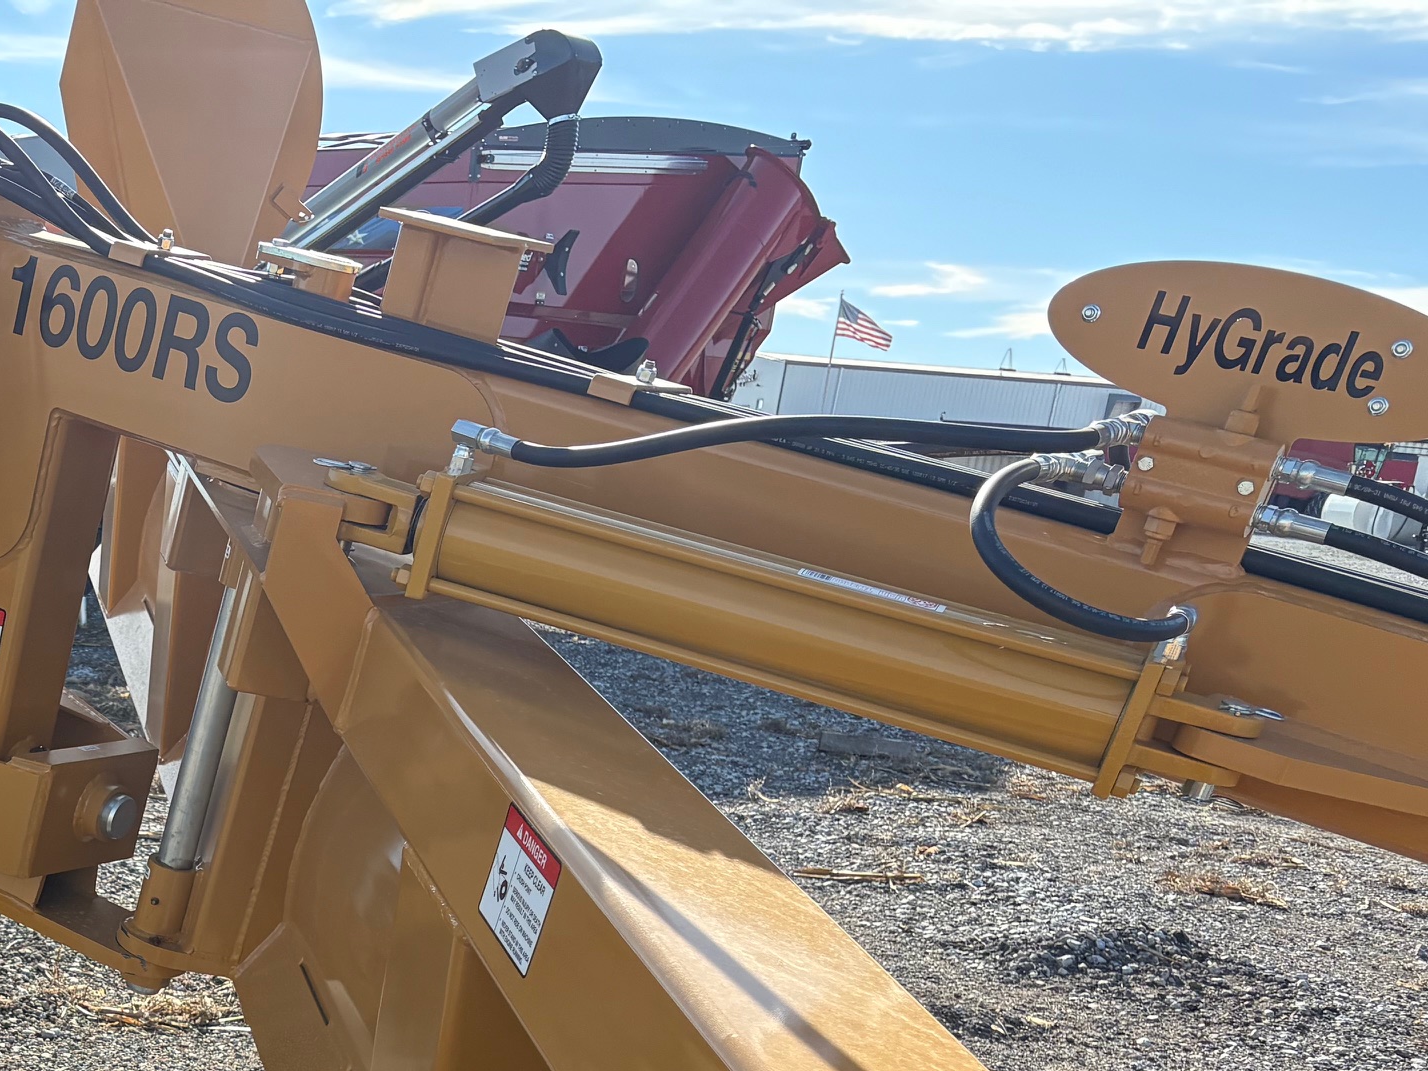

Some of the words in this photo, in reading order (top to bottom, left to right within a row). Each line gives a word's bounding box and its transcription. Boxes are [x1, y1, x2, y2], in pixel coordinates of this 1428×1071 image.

[12, 255, 258, 403] 1600RS
[1137, 290, 1384, 398] HyGrade
[522, 830, 547, 869] DANGER
[523, 862, 534, 881] KEEP
[532, 874, 545, 896] CLEAR
